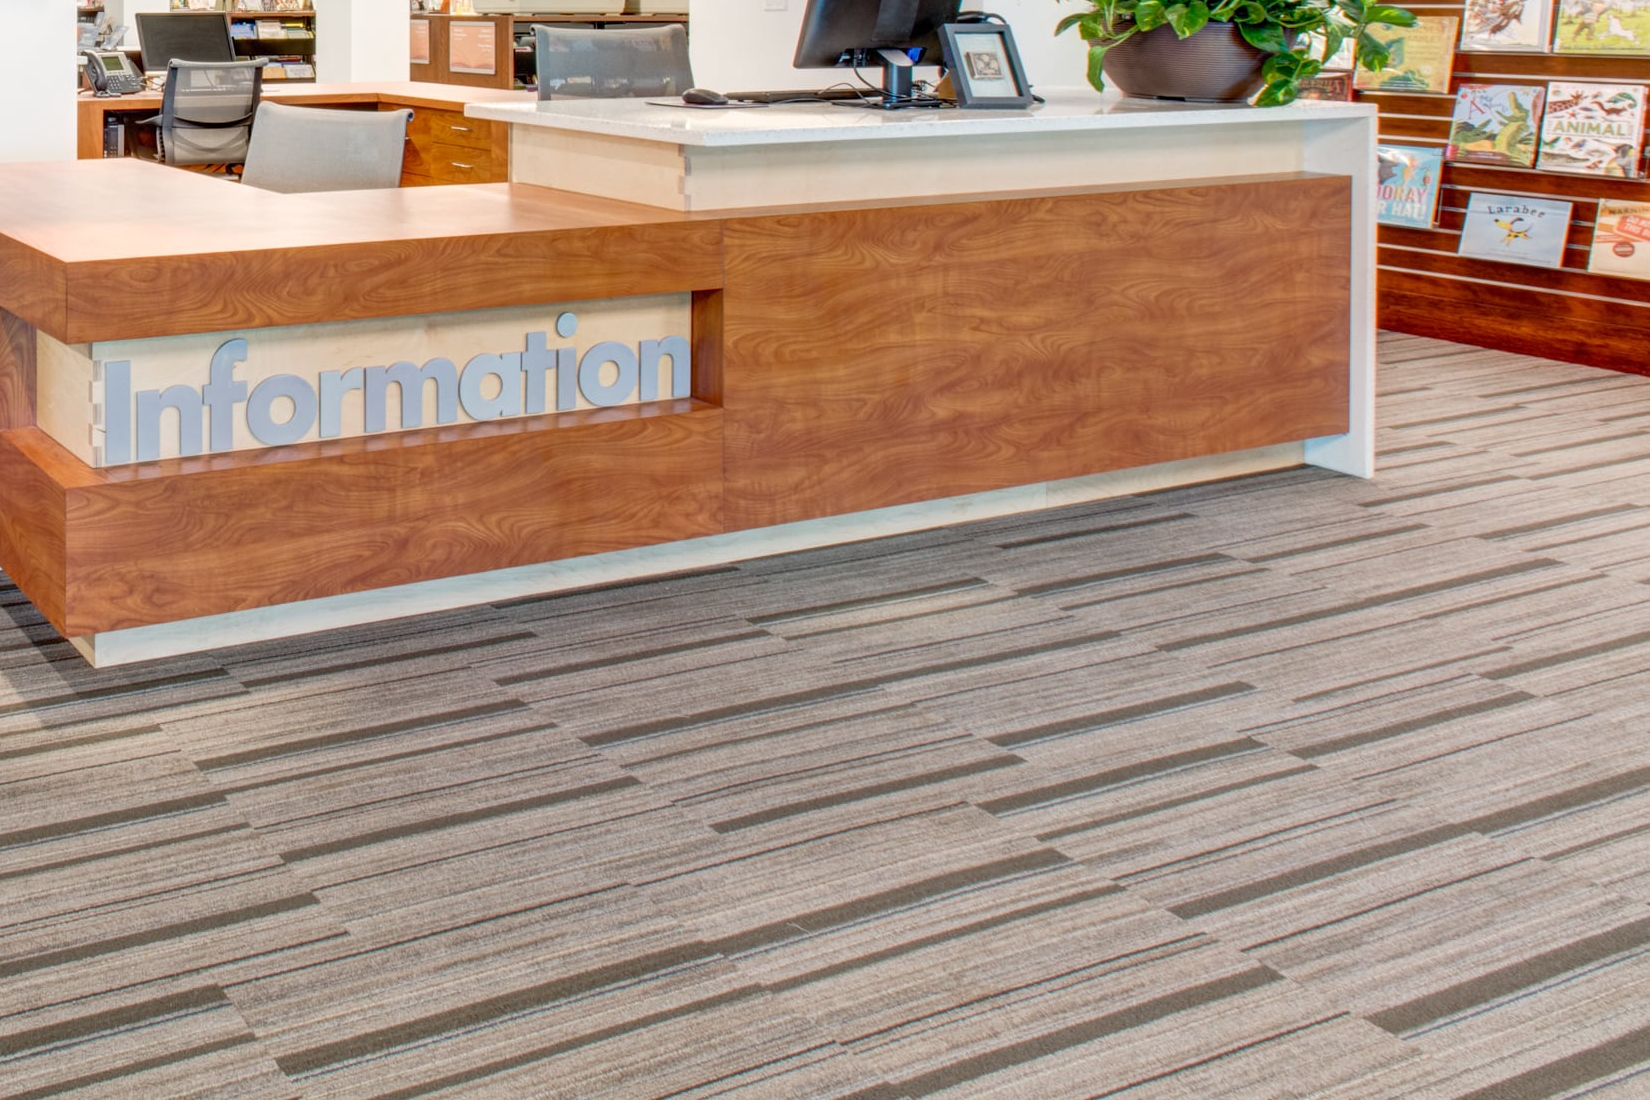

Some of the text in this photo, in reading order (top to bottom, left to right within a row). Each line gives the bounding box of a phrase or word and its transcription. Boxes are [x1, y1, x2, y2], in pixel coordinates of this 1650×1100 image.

[1553, 120, 1626, 136] ANIMAL
[1486, 205, 1547, 219] Larabee
[105, 312, 691, 464] Information
